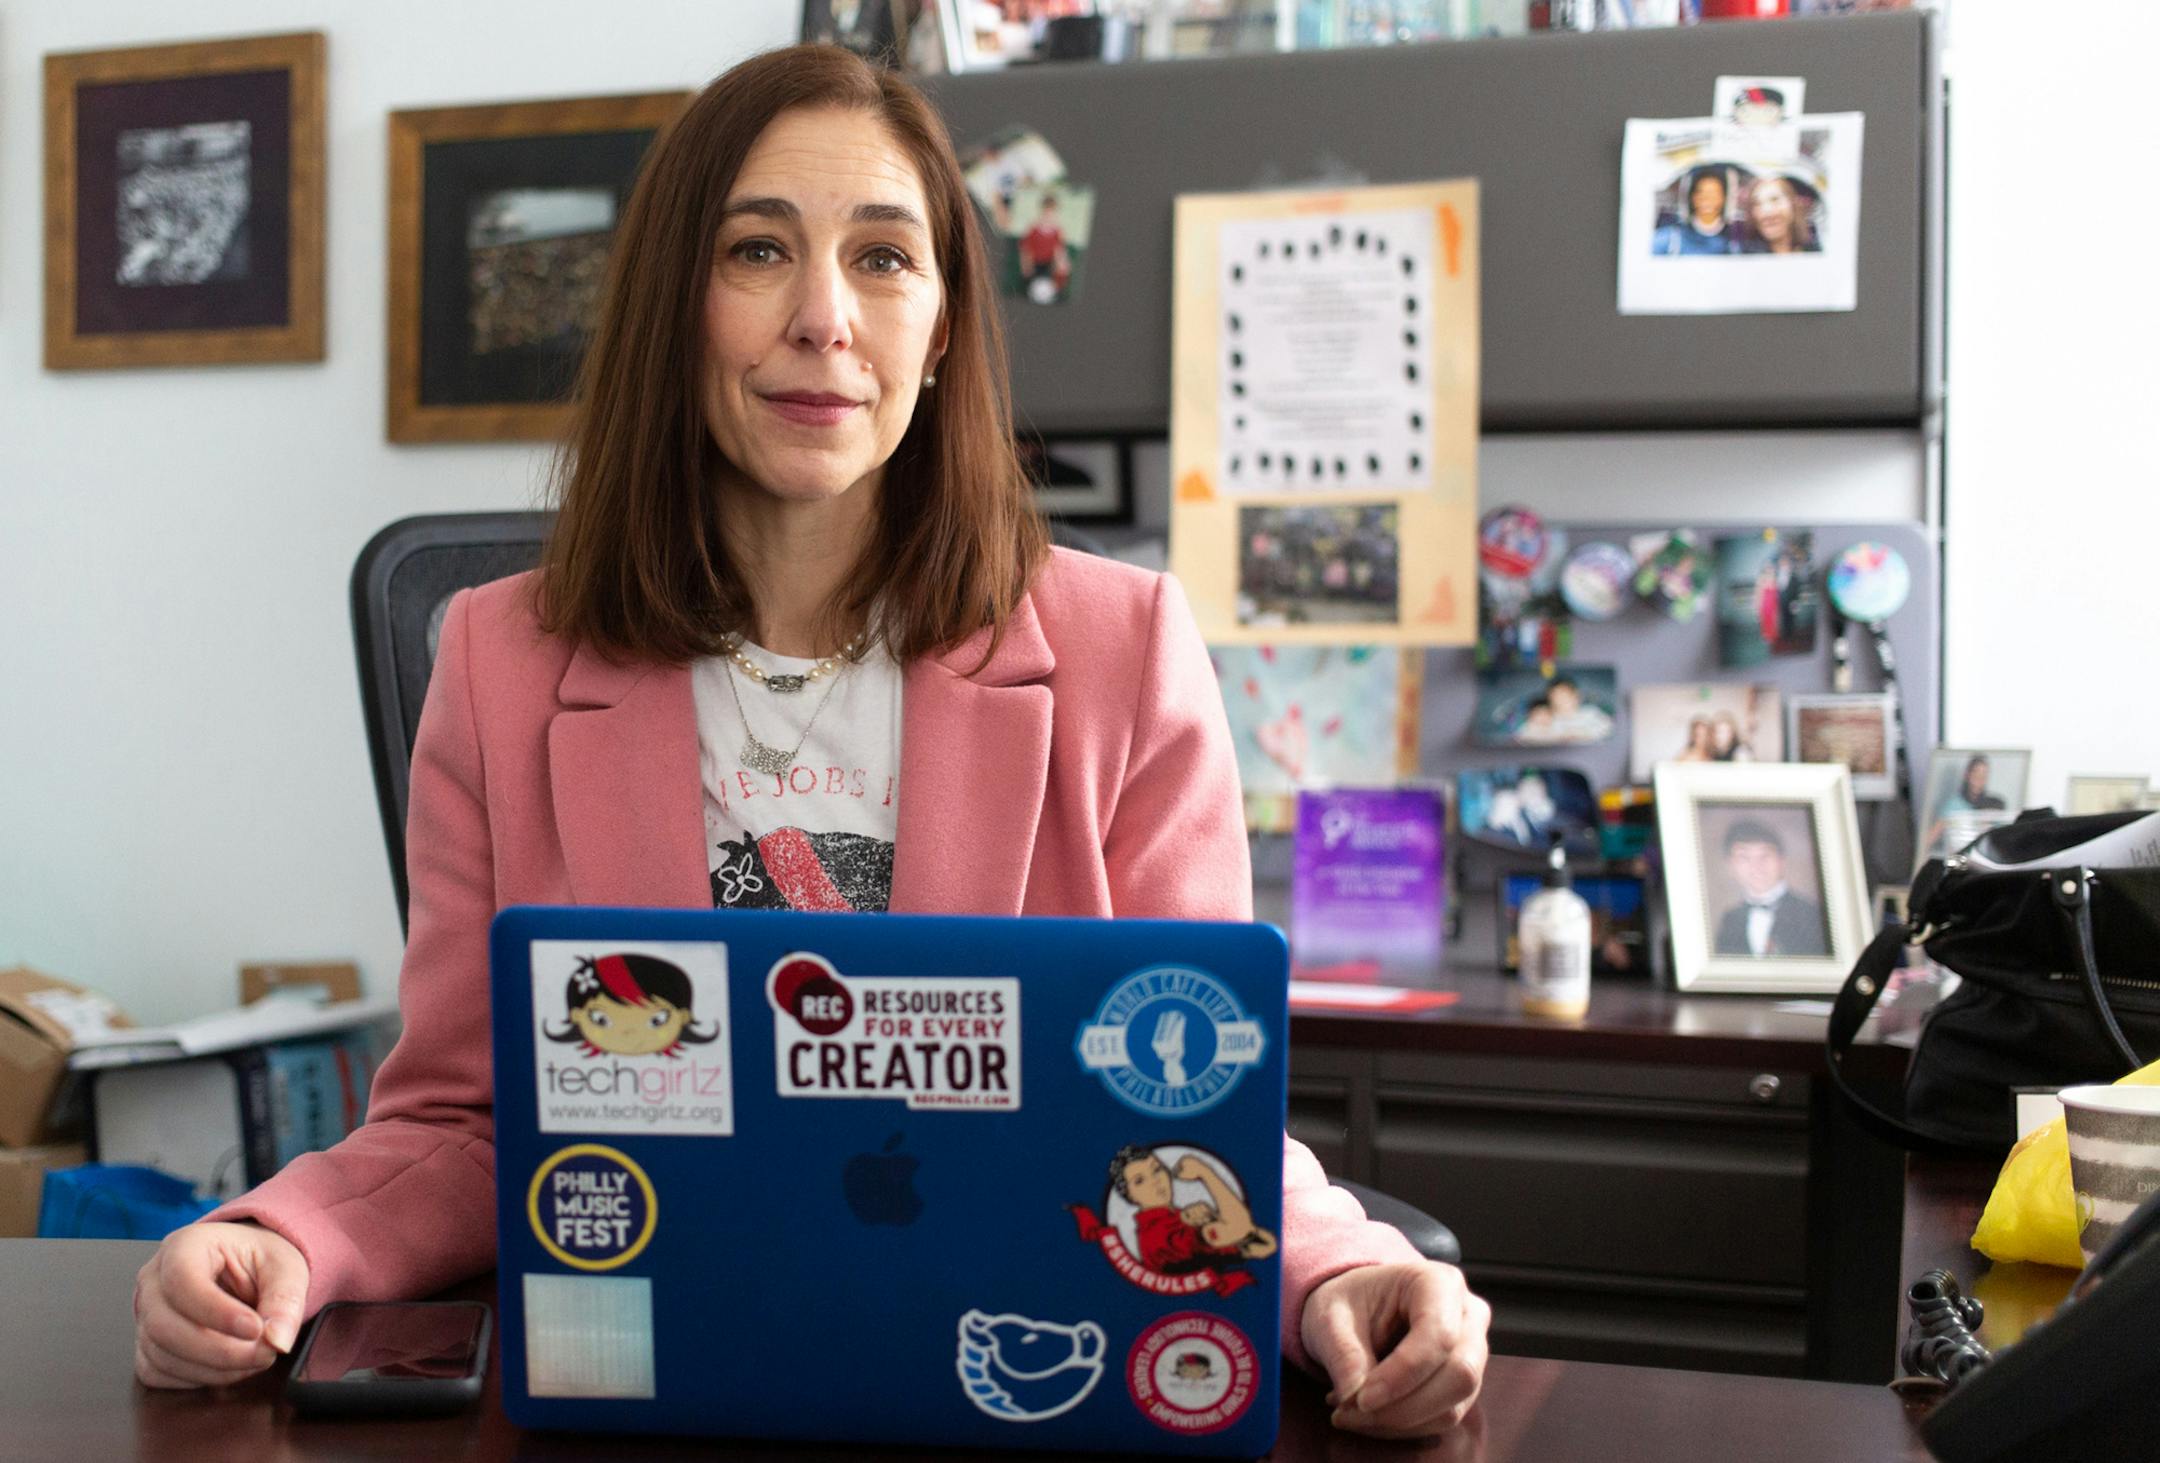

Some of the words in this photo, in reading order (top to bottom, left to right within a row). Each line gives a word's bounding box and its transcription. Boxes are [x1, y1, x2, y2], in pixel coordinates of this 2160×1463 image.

[772, 766, 866, 799] JOBS
[801, 995, 846, 1021] REC
[863, 990, 1005, 1015] RESOURCES
[864, 1017, 913, 1038] FOR
[923, 1017, 1006, 1039] EVERY
[789, 1040, 1008, 1092] CREATOR
[545, 1058, 722, 1105] techgirlz
[1112, 1064, 1235, 1108] PHILADELPHIA
[548, 1103, 723, 1124] www.techgirlz.org
[553, 1171, 629, 1194] PHILLY
[554, 1195, 631, 1218] MUSIC
[556, 1218, 632, 1249] FEST
